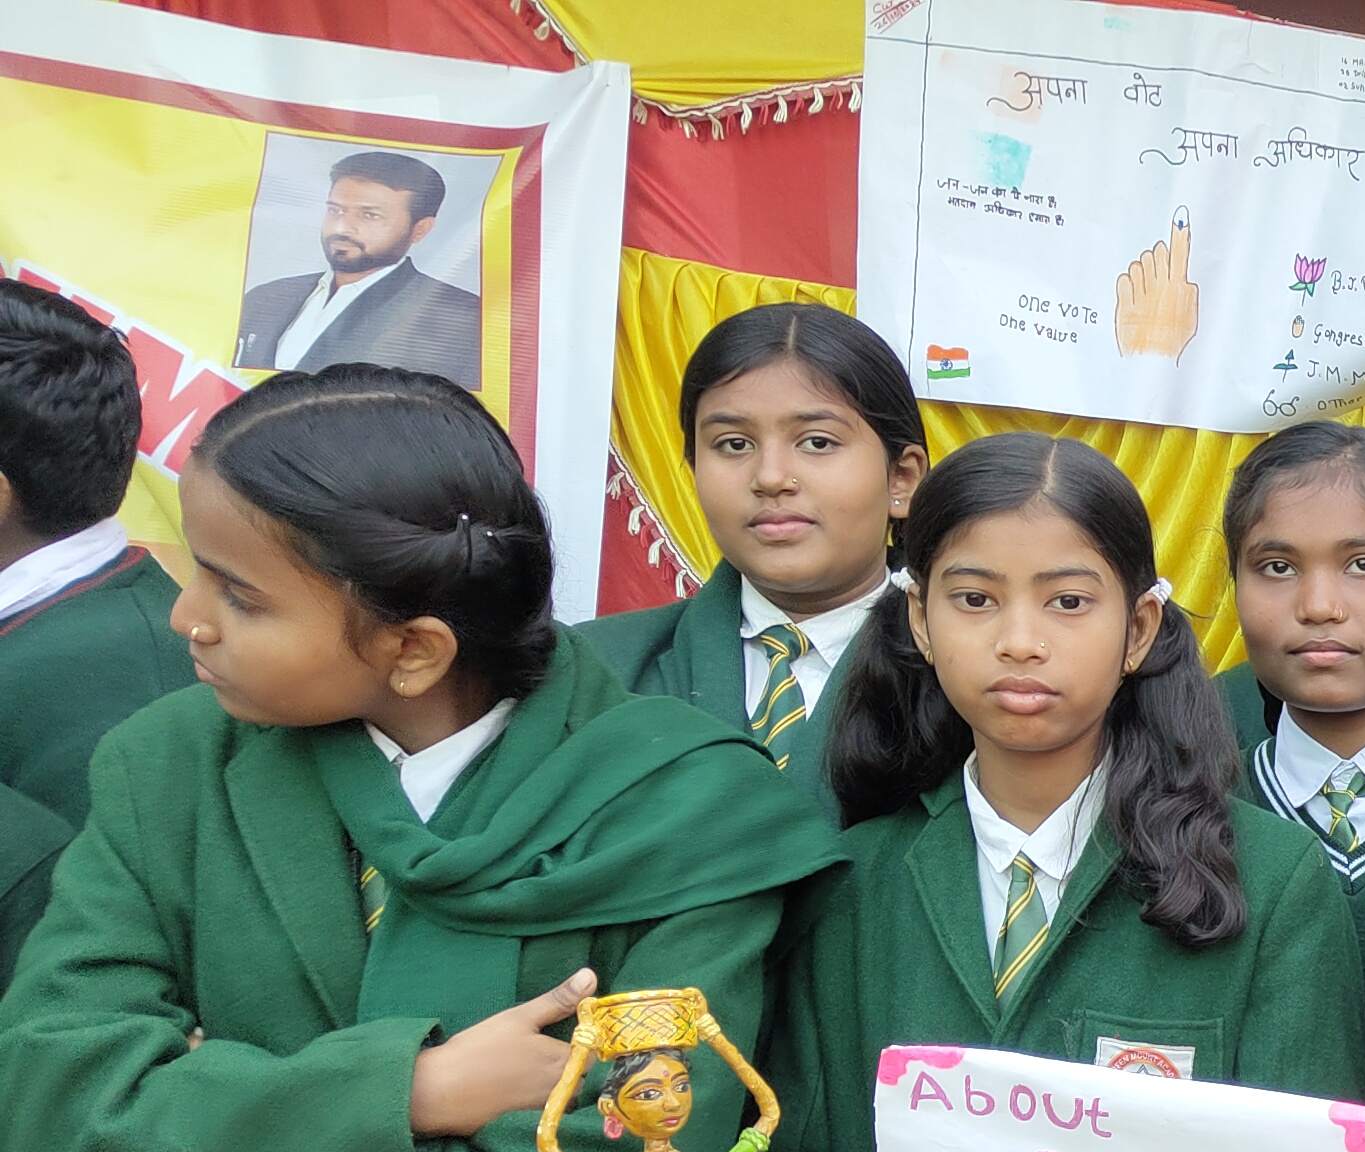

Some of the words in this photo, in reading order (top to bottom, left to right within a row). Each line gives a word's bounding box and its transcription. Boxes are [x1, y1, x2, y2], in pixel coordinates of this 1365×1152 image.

[986, 71, 1088, 112] अपना
[1123, 72, 1162, 107] वोट
[1140, 126, 1238, 165] अपना
[1253, 126, 1365, 181] अधिकार
